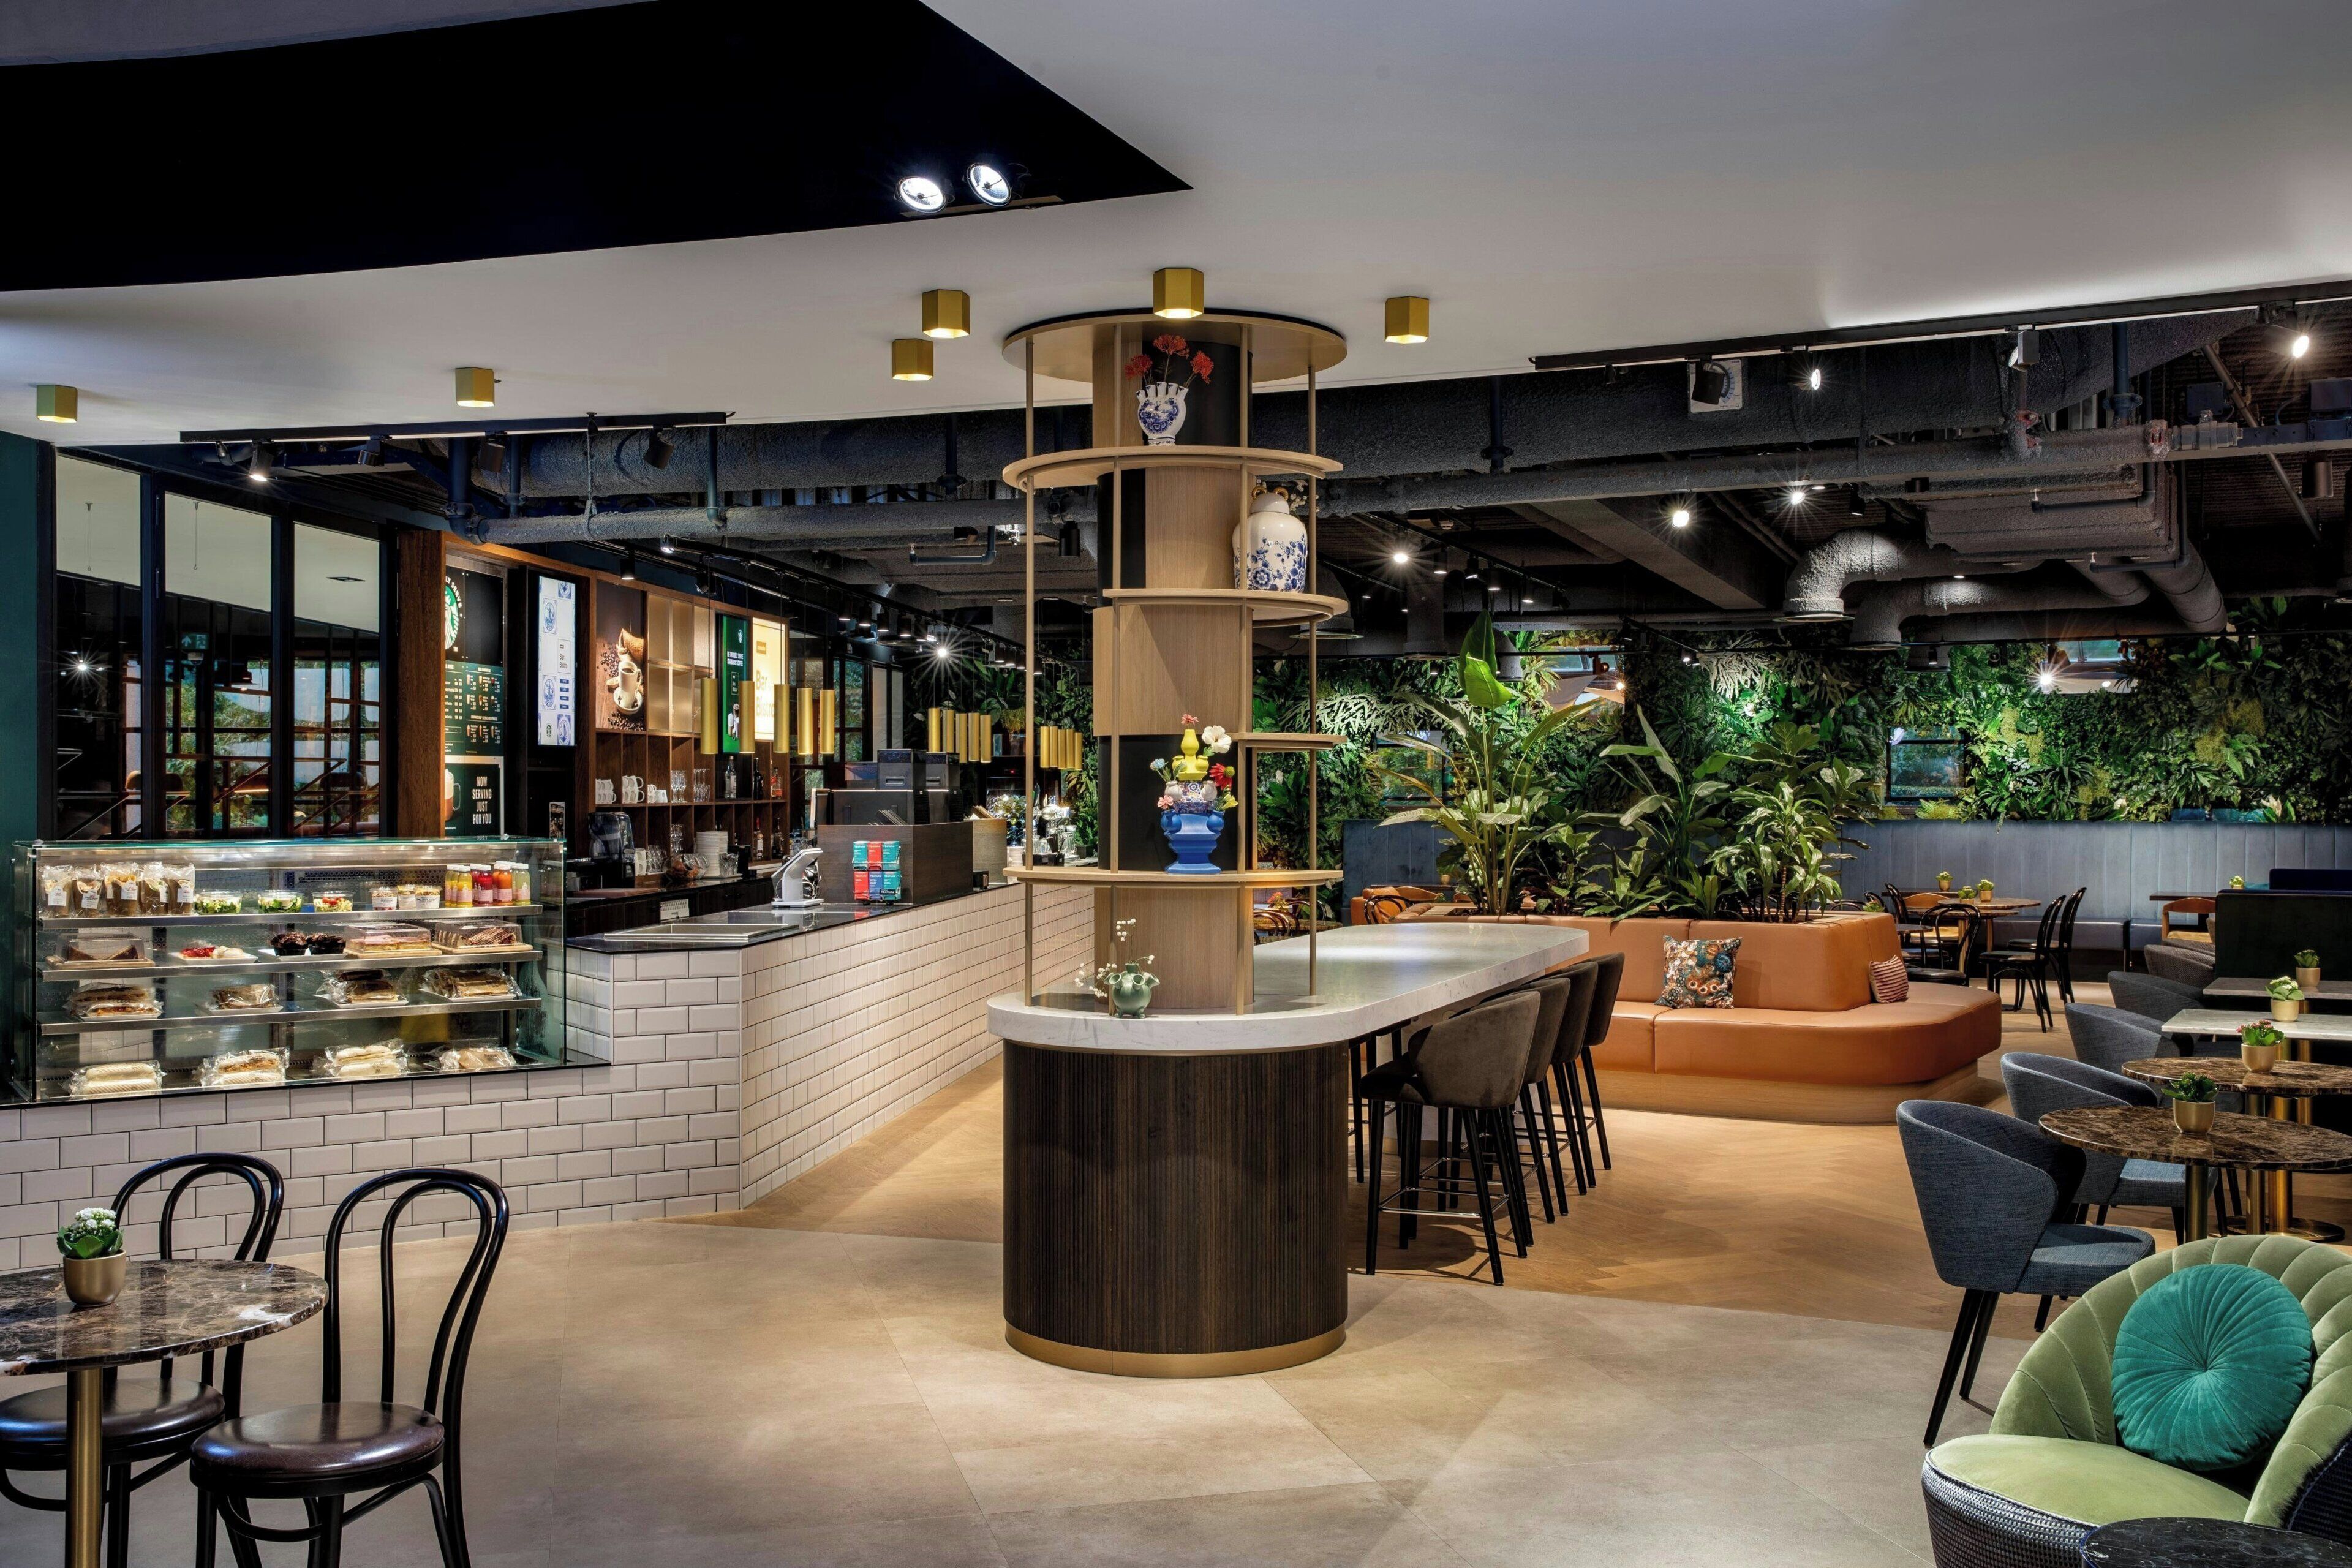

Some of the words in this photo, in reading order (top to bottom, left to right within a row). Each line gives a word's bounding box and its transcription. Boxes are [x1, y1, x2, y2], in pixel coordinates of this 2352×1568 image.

[756, 670, 767, 691] Bar
[477, 776, 488, 787] NOW
[472, 788, 492, 799] SERVING
[477, 801, 488, 812] JUST
[473, 814, 482, 824] FOR
[482, 813, 492, 824] YOU
